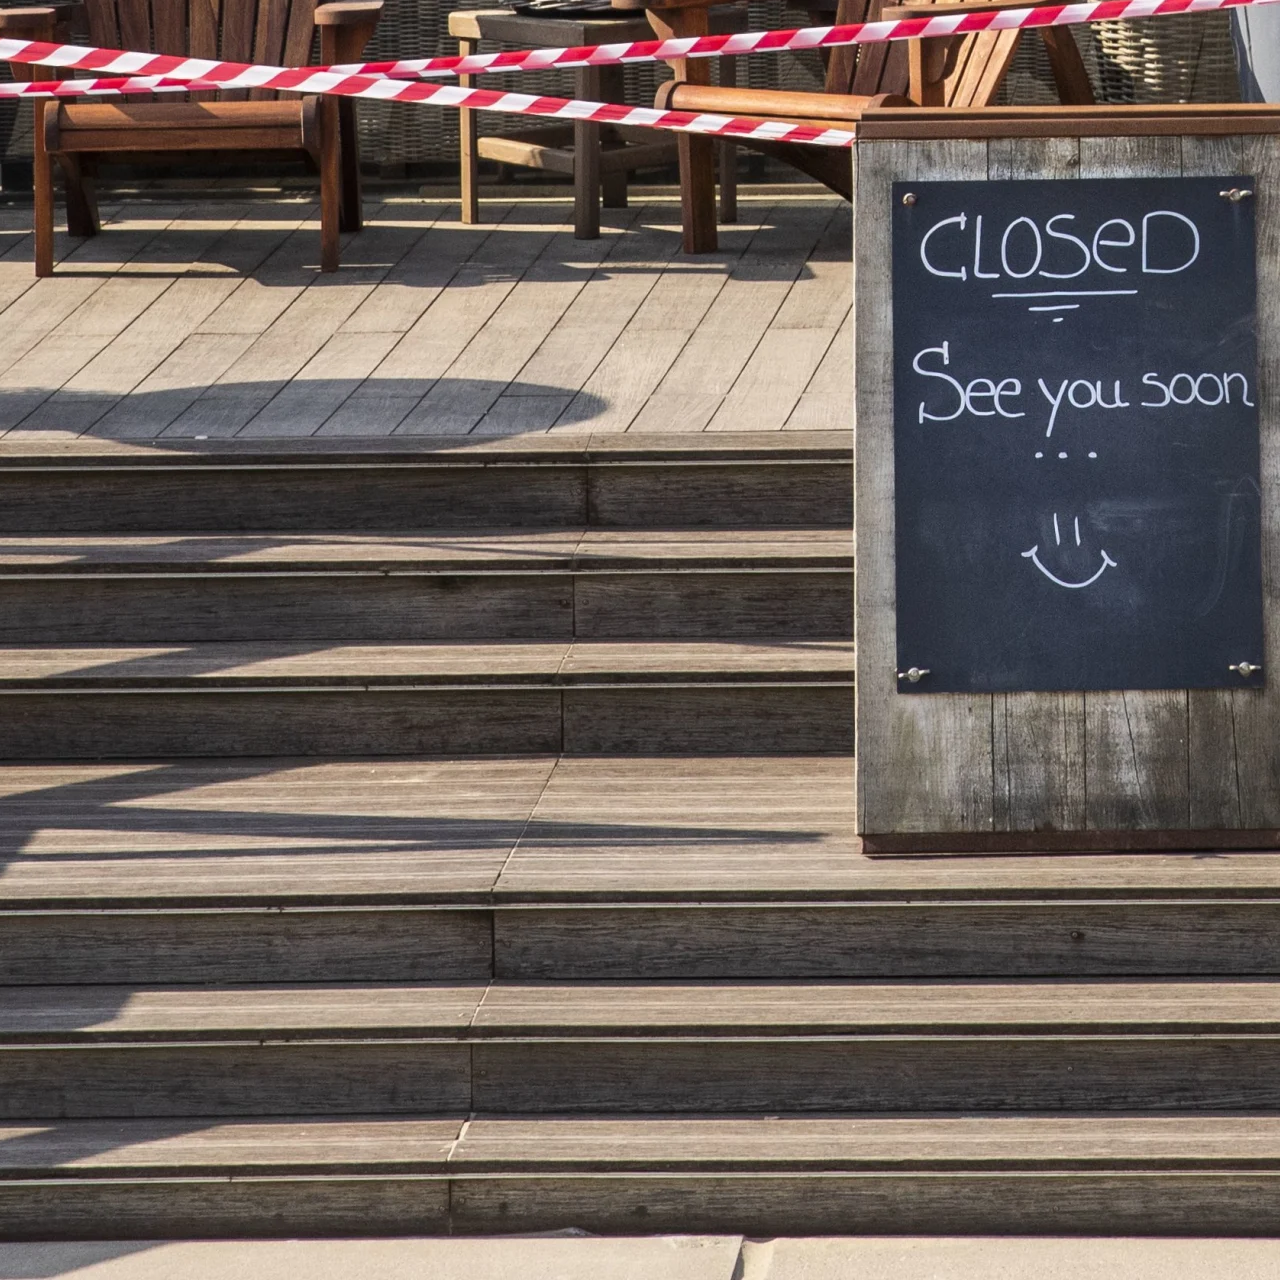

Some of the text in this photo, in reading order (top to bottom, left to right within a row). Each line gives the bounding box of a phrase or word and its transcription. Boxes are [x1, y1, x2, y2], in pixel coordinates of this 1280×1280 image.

[920, 210, 1200, 282] CLOSeD
[912, 340, 1255, 438] See you soon
